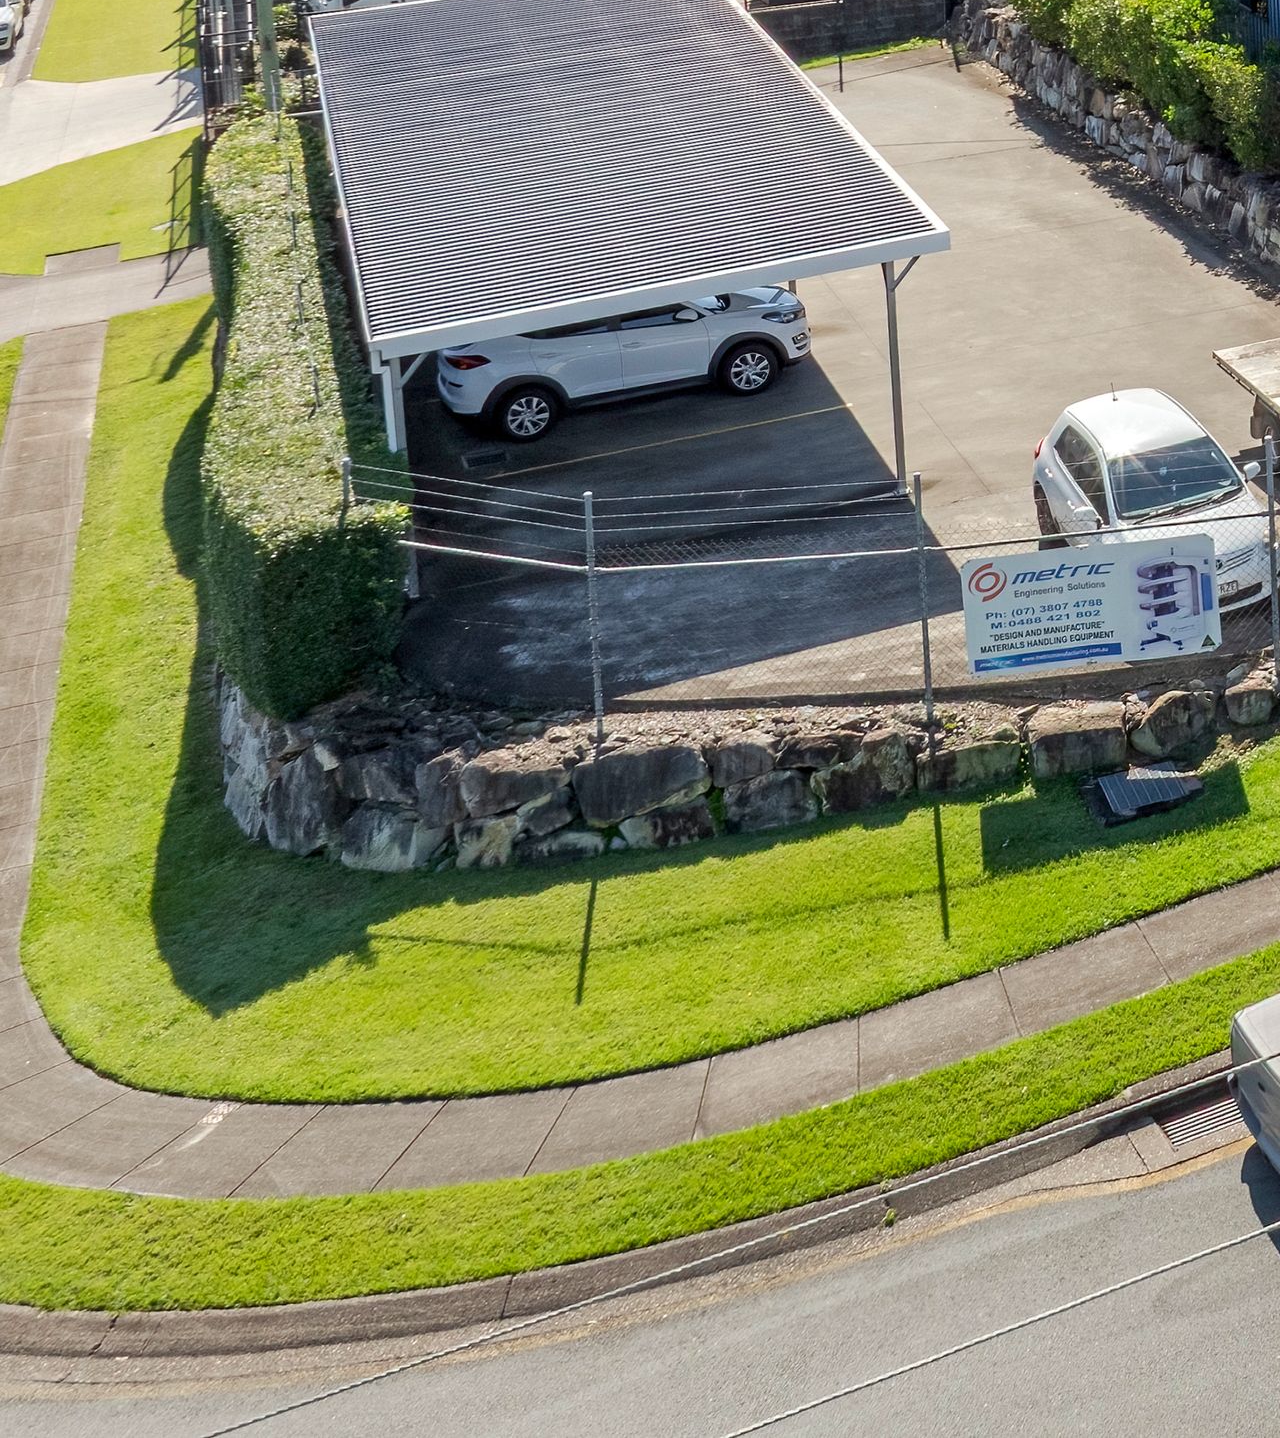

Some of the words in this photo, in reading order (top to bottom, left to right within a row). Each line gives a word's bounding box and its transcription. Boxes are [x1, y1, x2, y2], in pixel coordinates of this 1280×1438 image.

[1011, 562, 1115, 585] metric
[1014, 586, 1064, 599] Engineering
[1067, 580, 1106, 592] Solutions
[985, 611, 1007, 620] Ph:
[1011, 607, 1035, 618] (07)
[1039, 602, 1069, 613] 3807
[1072, 598, 1103, 608] 4788
[1046, 613, 1071, 622] 421
[1075, 609, 1101, 619] 802
[980, 641, 1025, 654] MATERIALS
[1026, 635, 1068, 648] HANDLING
[1069, 630, 1115, 642] EQUIPMENT
[1024, 628, 1042, 638] AND
